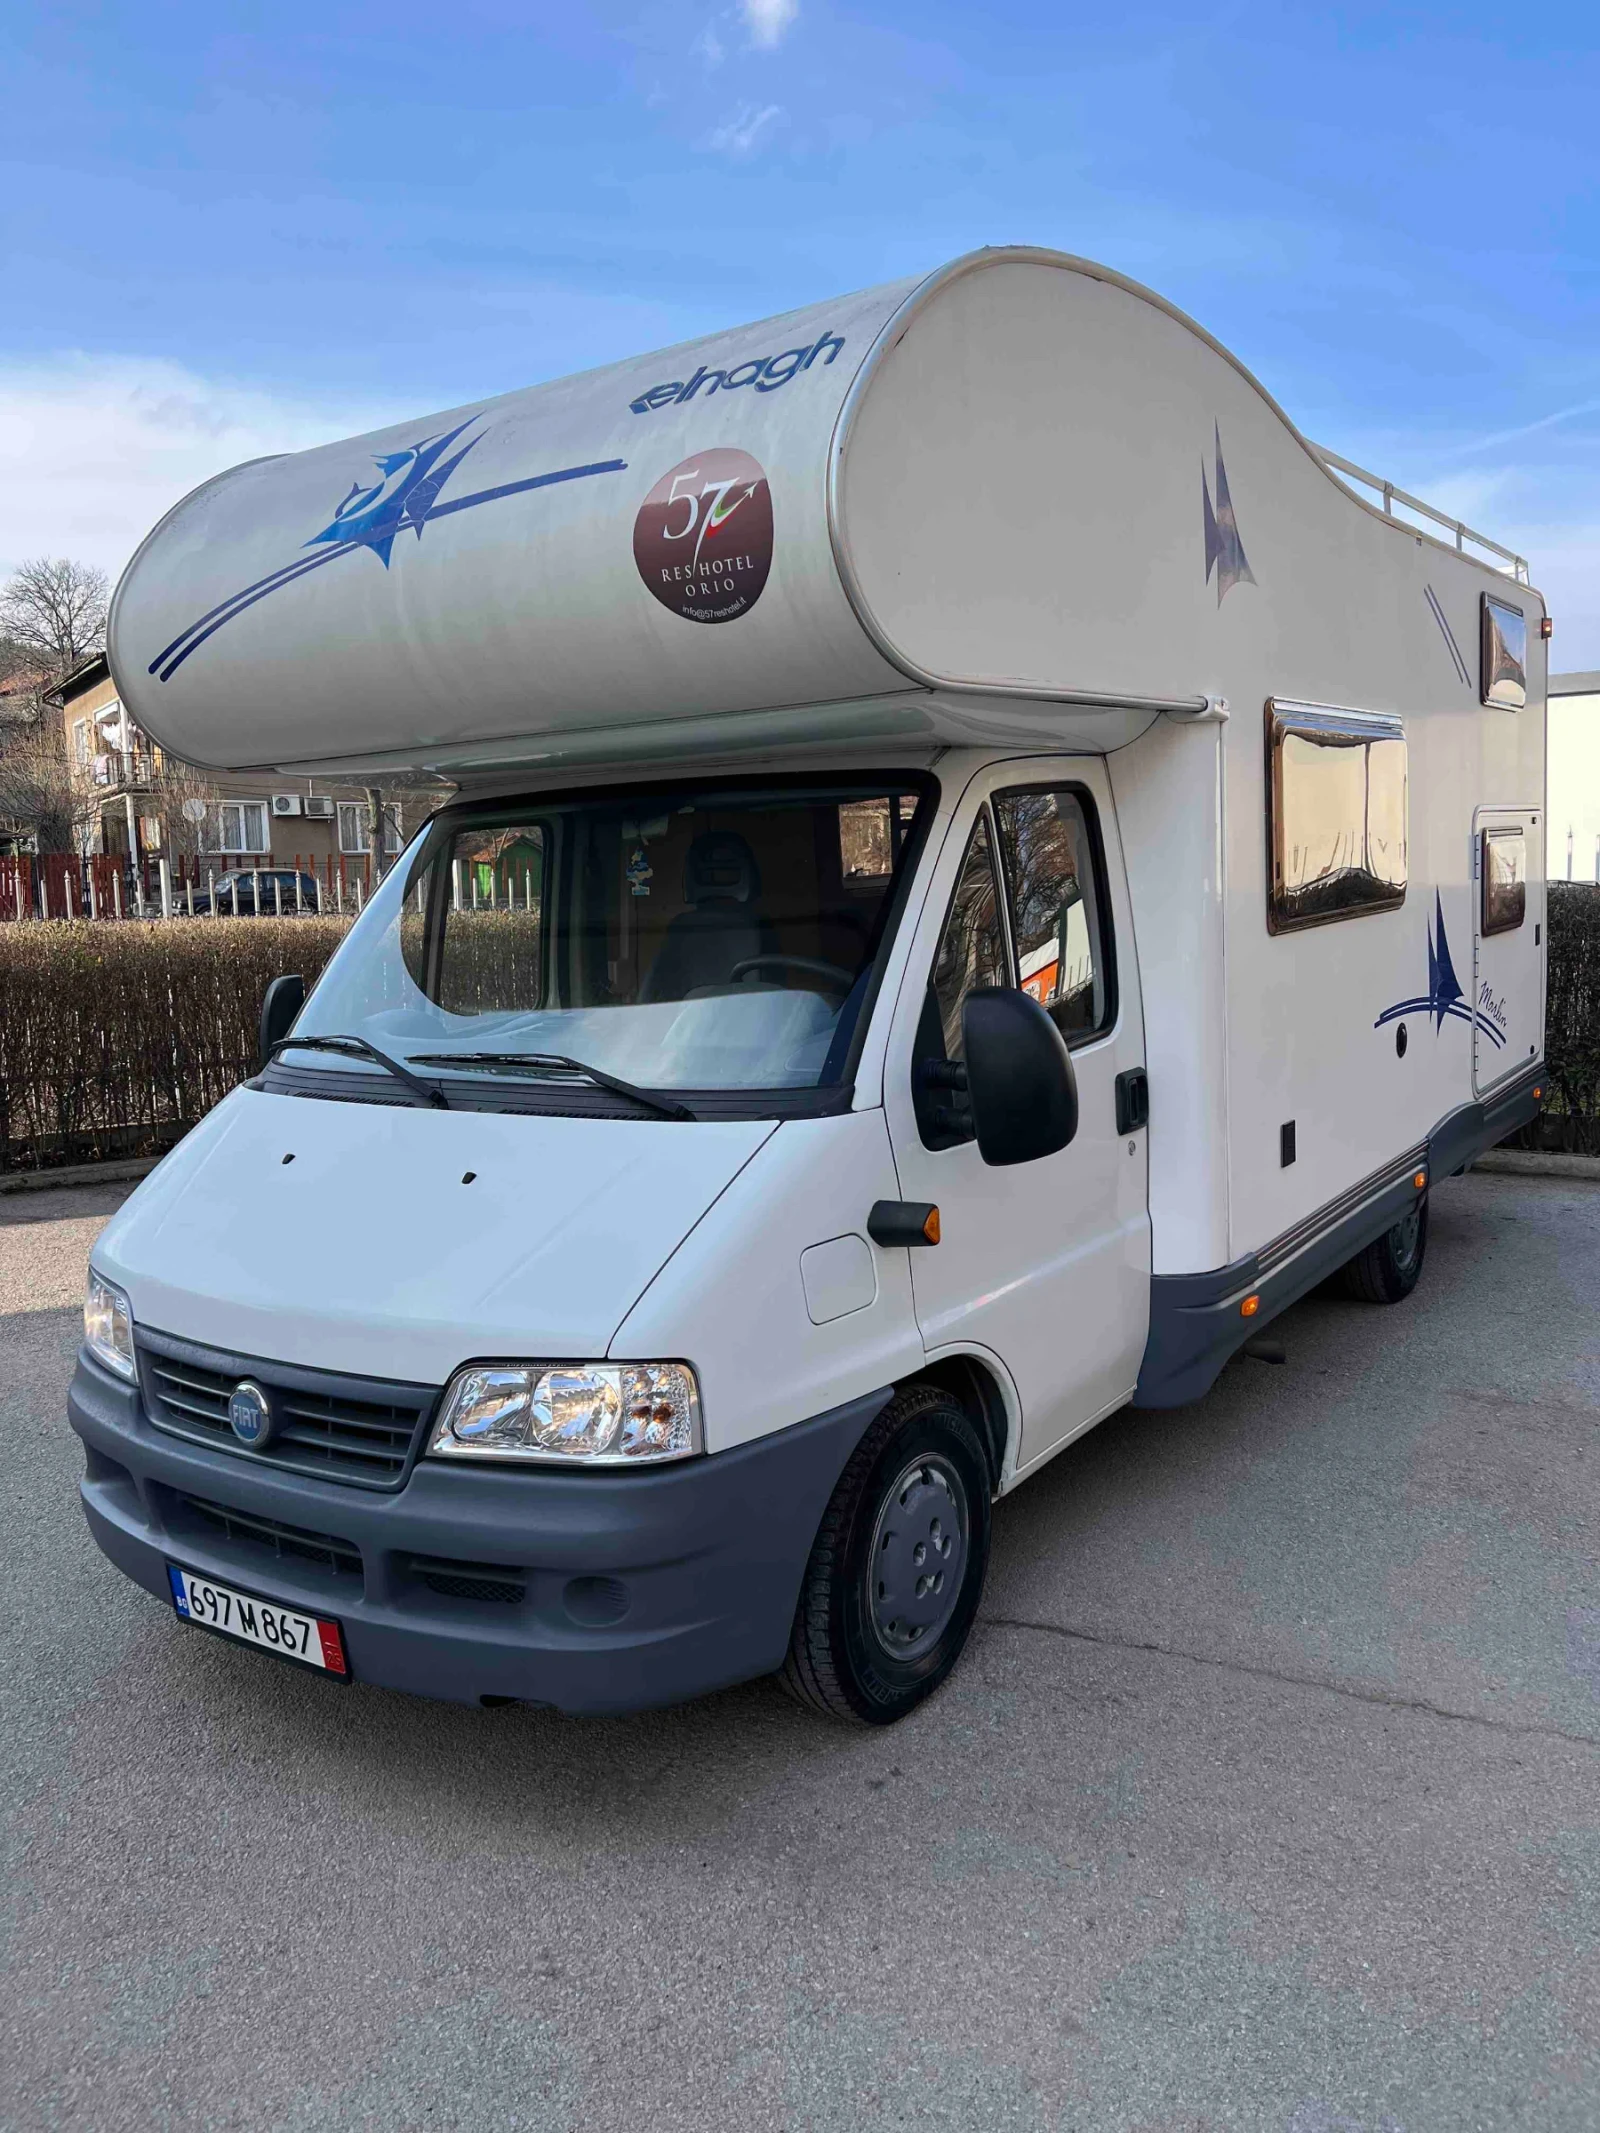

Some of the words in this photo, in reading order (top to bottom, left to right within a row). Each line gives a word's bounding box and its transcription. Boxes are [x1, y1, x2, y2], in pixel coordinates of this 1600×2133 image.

[629, 331, 846, 414] elnagh
[663, 469, 740, 577] 57
[661, 564, 692, 582] RES
[699, 555, 754, 576] HOTEL
[685, 578, 735, 597] ORIO
[682, 596, 747, 619] info@57reshotel.it
[232, 1404, 259, 1429] FIAT
[190, 1581, 231, 1626] 697
[236, 1598, 260, 1638] M
[261, 1608, 310, 1655] 867
